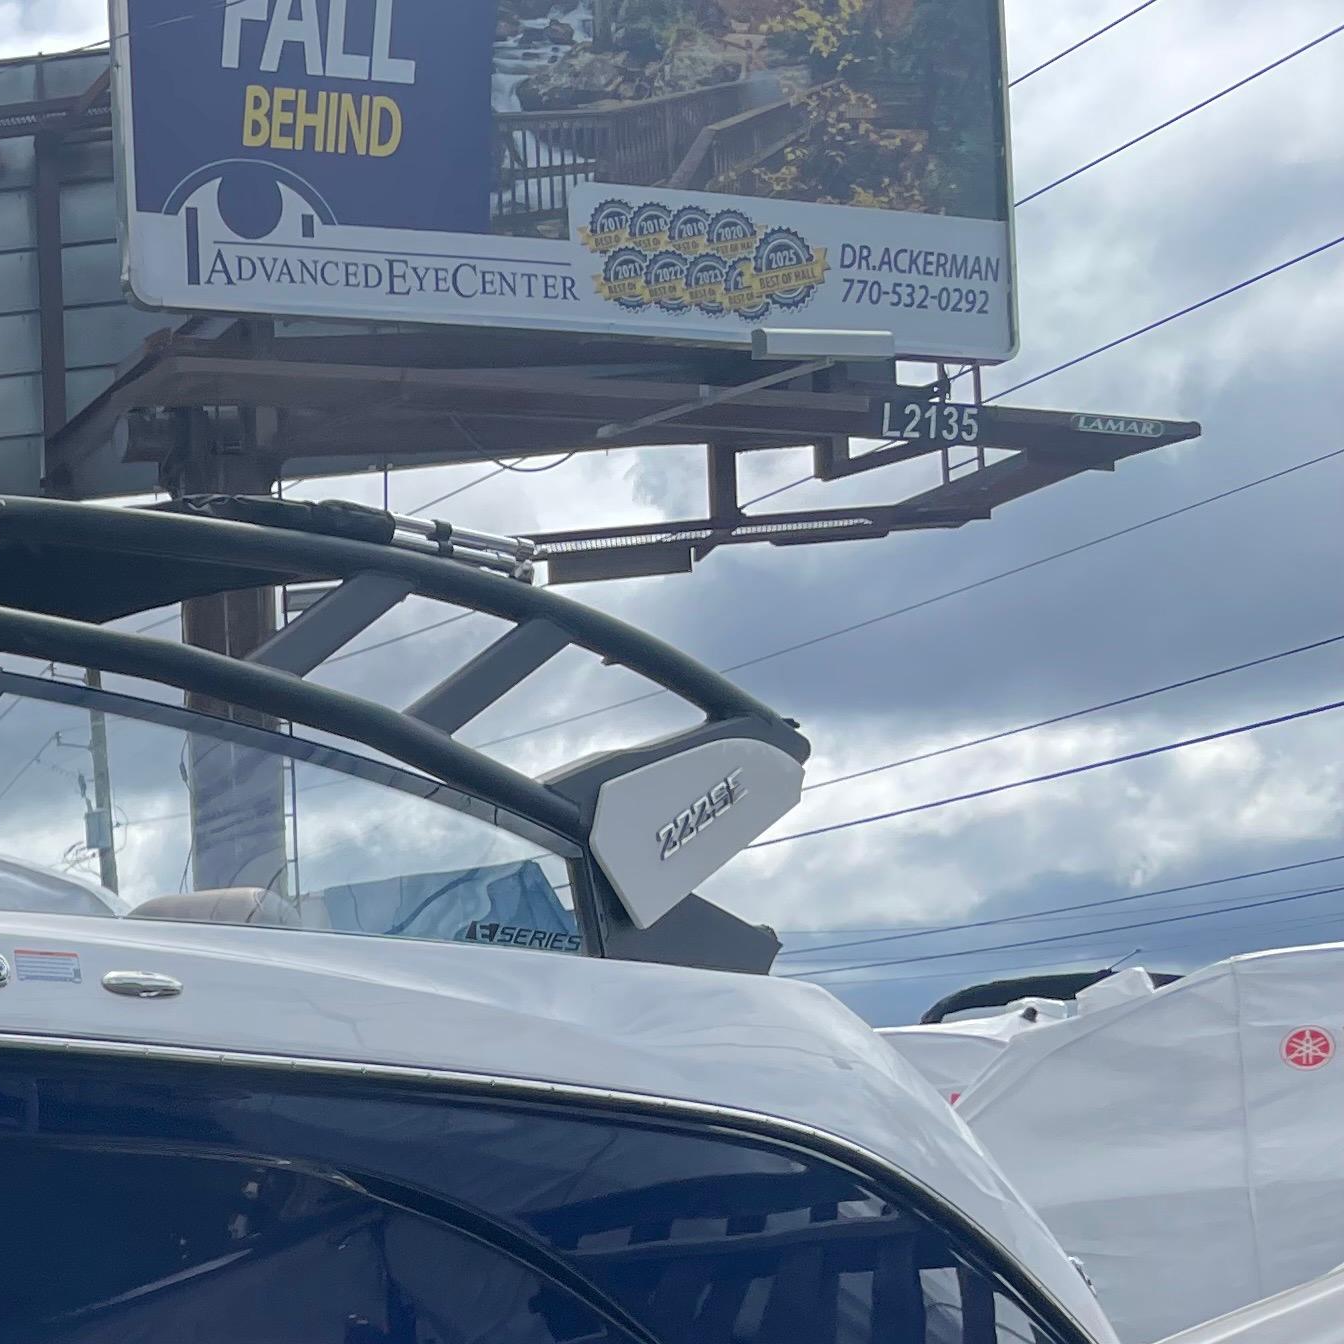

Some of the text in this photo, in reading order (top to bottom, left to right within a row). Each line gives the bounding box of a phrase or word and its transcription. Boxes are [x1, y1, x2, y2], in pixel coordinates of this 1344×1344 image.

[222, 0, 416, 84] FALL
[242, 84, 403, 158] BEHIND
[602, 216, 626, 232] 2017
[680, 221, 704, 237] 2019
[718, 225, 744, 241] 2020
[769, 249, 797, 269] 2025
[840, 243, 1000, 282] DR.ACKERMAN
[616, 263, 641, 279] 2021
[657, 266, 682, 282] 2022
[759, 275, 779, 289] BEST
[781, 272, 792, 284] OF
[794, 267, 816, 282] HALL
[842, 278, 990, 314] 770-532-0292
[882, 402, 979, 442] L2135
[1078, 416, 1154, 434] LAMAR
[497, 926, 583, 951] SERIES
